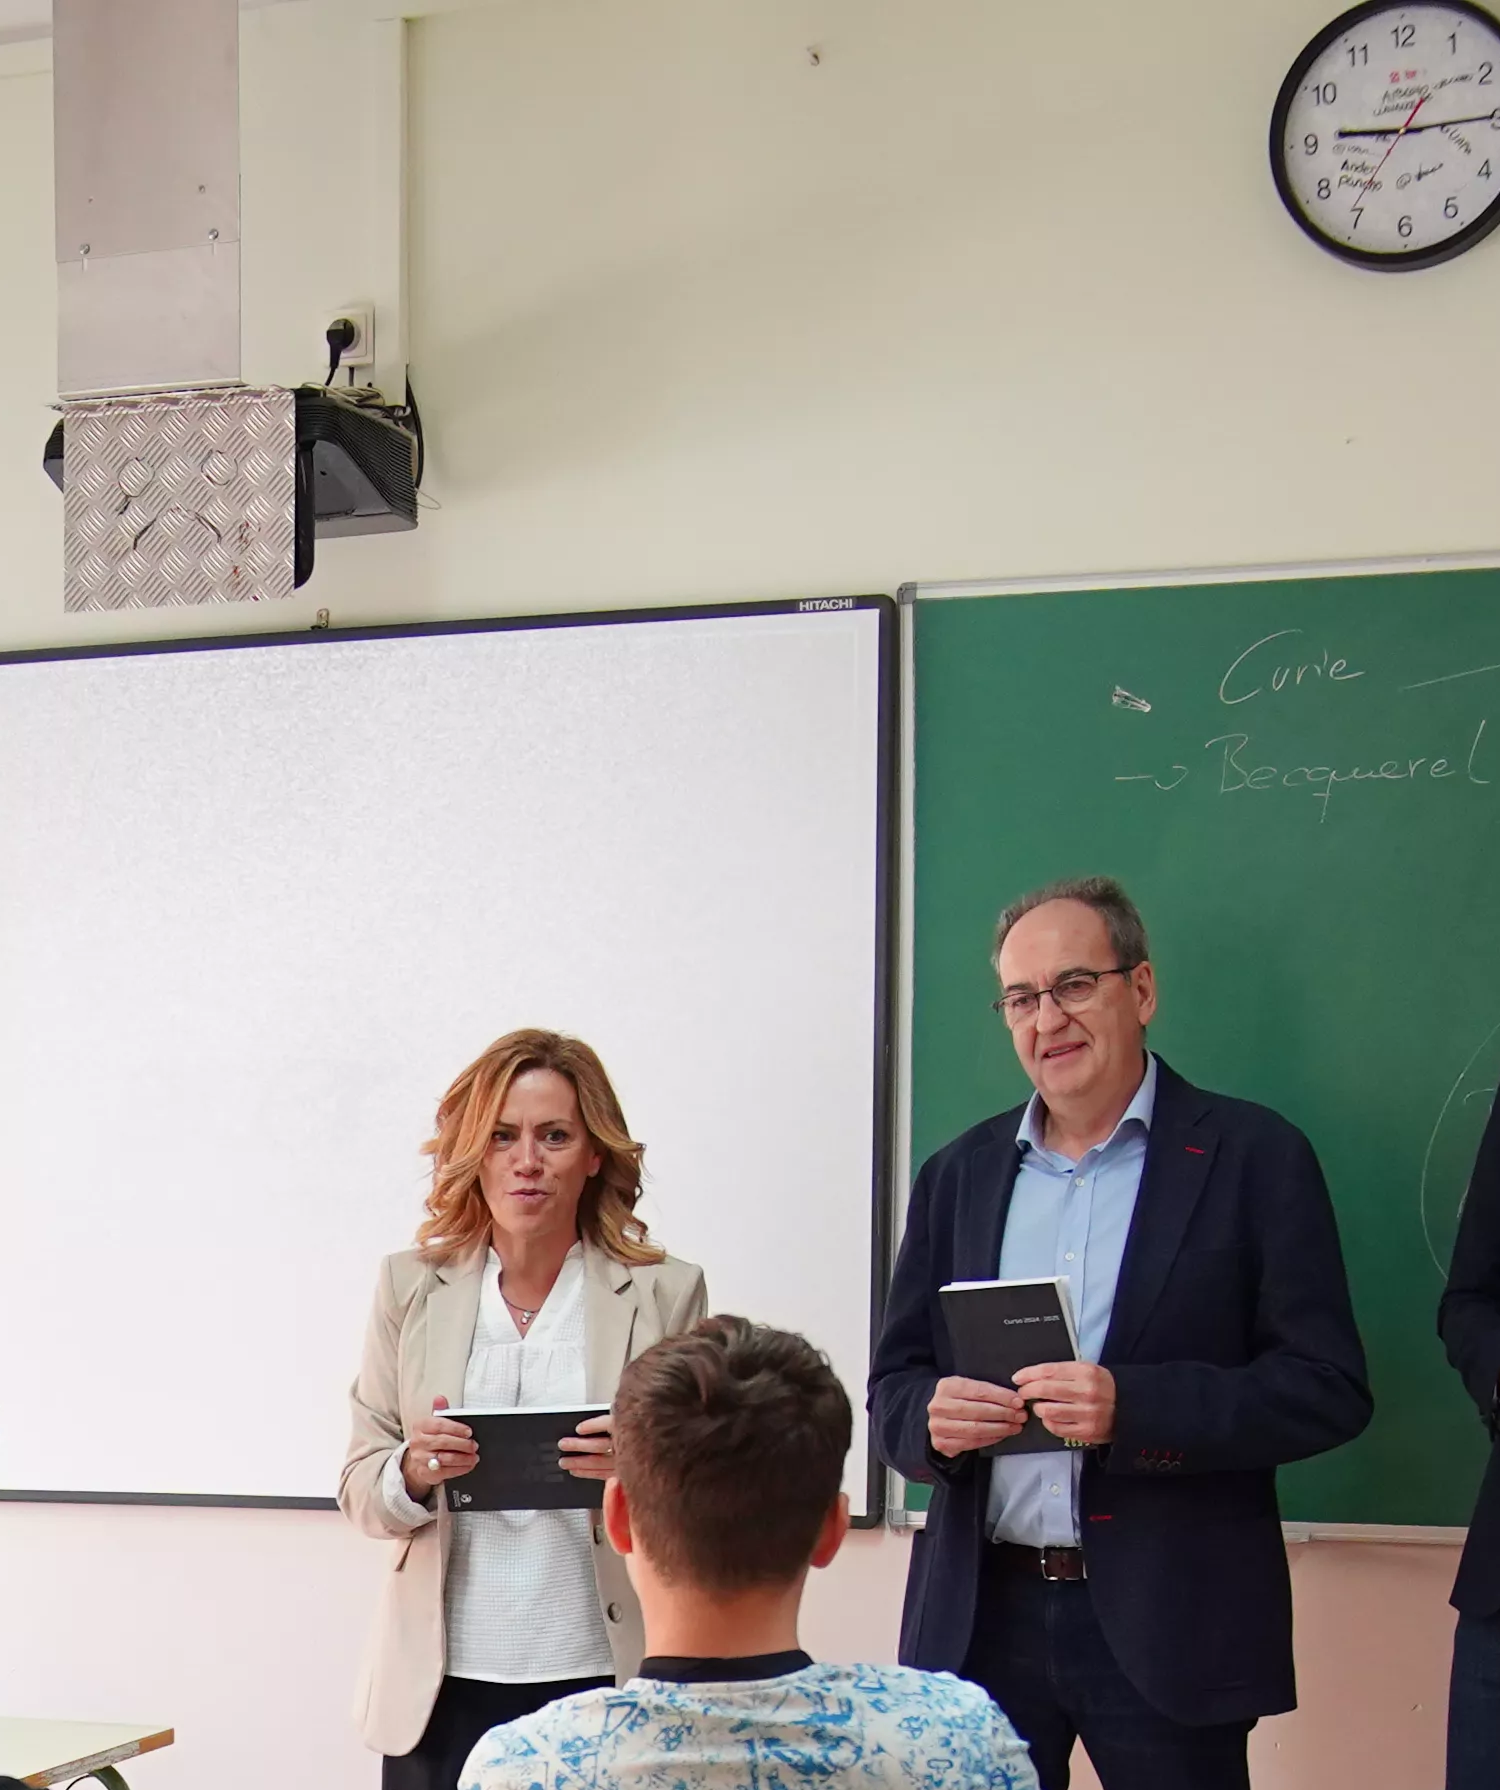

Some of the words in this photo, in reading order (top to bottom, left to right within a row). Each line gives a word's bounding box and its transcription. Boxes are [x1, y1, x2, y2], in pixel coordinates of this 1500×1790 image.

[1390, 24, 1416, 49] 12
[1447, 32, 1457, 54] 1
[1347, 44, 1369, 67] 11
[1478, 61, 1494, 86] 2
[1311, 82, 1338, 107] 10
[1303, 133, 1319, 156] 9
[1477, 158, 1493, 181] 4
[1316, 178, 1332, 200] 8
[1351, 206, 1365, 230] 7
[1444, 196, 1459, 219] 5
[1397, 215, 1413, 238] 6
[799, 598, 853, 611] HITACHI
[1217, 628, 1366, 706] Curie
[1204, 718, 1492, 824] Becquerel
